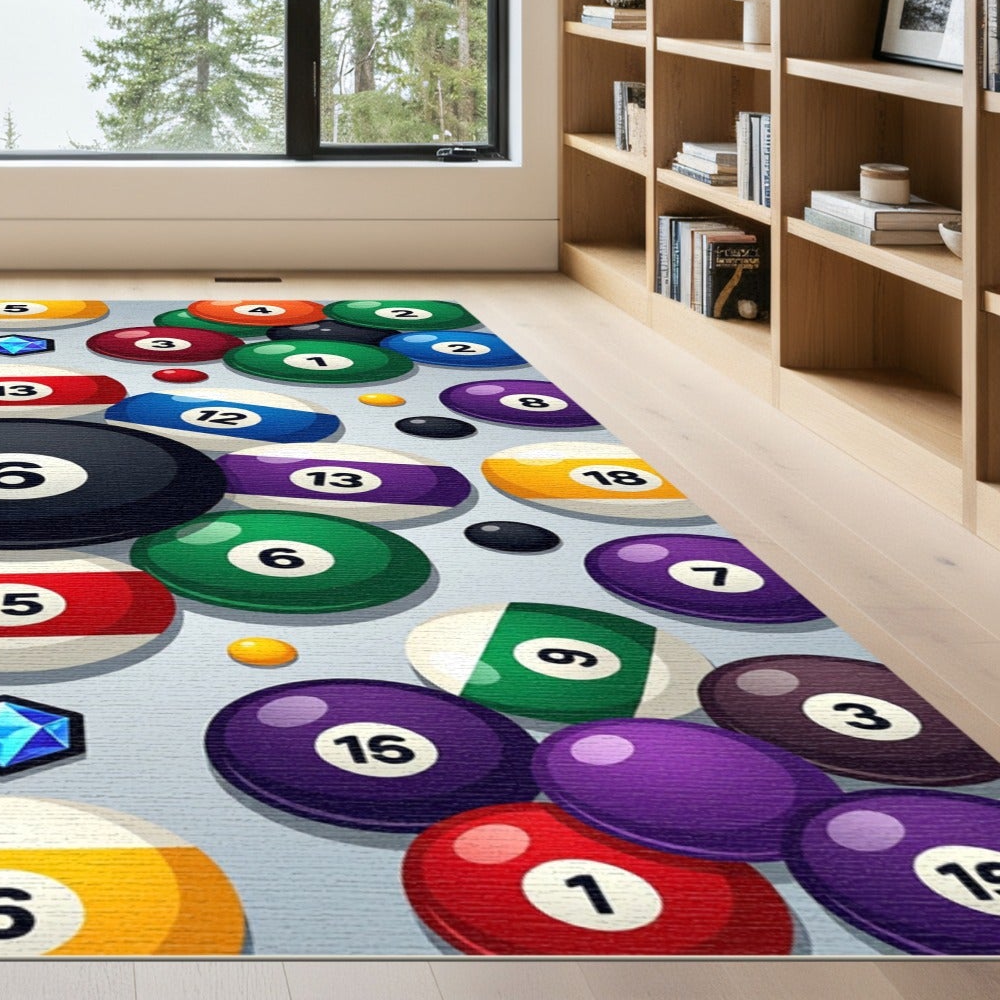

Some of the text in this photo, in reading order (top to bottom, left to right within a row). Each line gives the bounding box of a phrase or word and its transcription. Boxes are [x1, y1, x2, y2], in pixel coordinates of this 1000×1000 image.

[4, 304, 29, 313] 5
[391, 309, 420, 318] 2
[151, 340, 176, 349] 3
[447, 344, 477, 354] 2
[306, 356, 328, 367] 1
[518, 397, 550, 409] 8
[196, 410, 248, 427] 12
[306, 471, 364, 489] 13
[582, 470, 648, 486] 18
[258, 547, 305, 570] 6
[690, 567, 728, 587] 7
[832, 702, 892, 731] 3
[565, 874, 615, 915] 1
